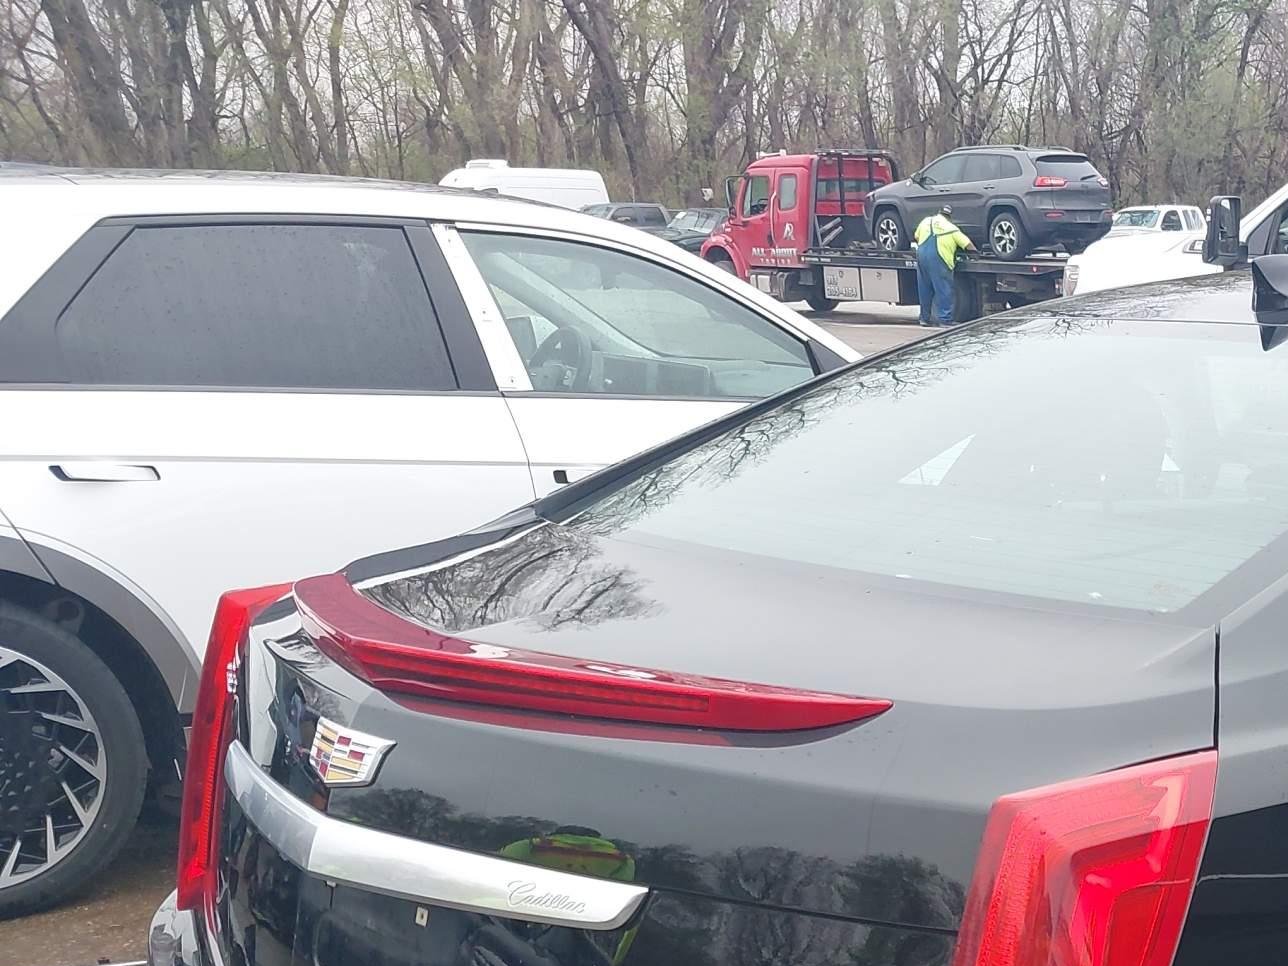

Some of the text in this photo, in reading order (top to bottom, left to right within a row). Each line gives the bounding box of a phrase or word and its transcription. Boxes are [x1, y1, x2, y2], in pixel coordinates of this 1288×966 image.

[752, 247, 797, 257] ALL ABOUT
[507, 880, 586, 914] Cadillac
